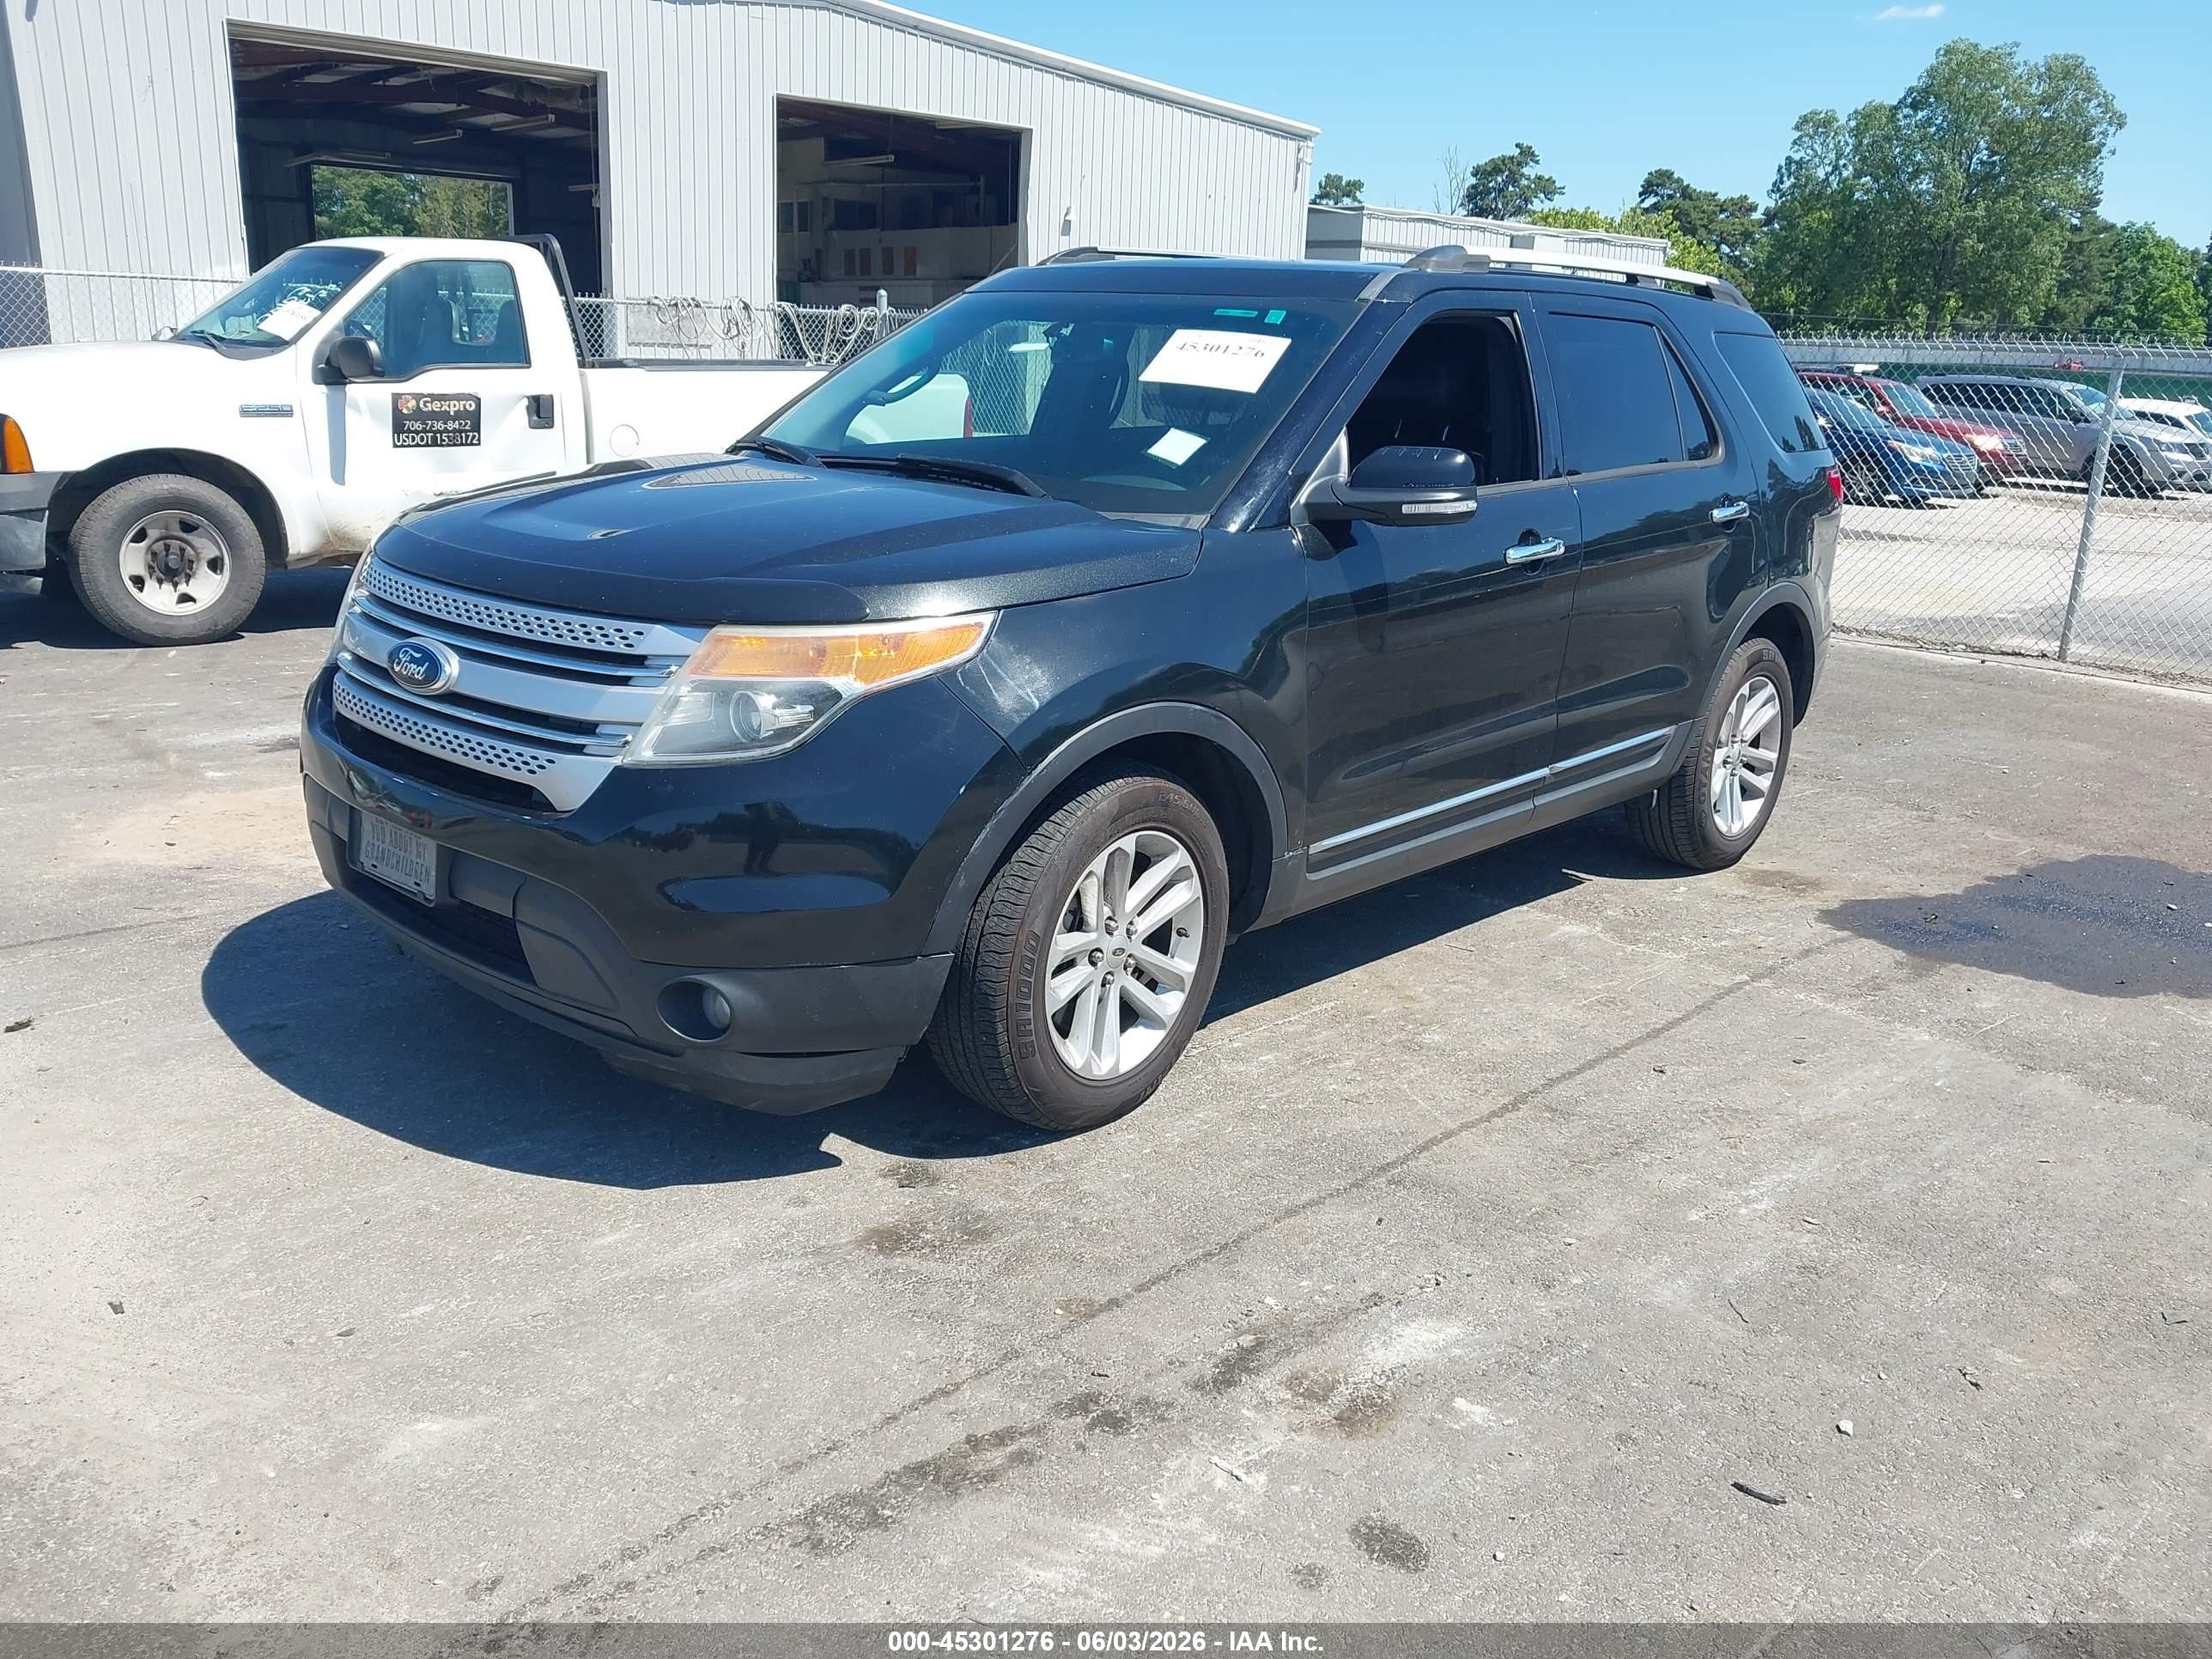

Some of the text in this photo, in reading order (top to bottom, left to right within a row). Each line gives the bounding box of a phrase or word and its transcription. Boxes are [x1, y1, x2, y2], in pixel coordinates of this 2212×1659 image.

[1176, 342, 1265, 358] 45301276
[419, 397, 476, 416] Gexpro
[403, 419, 471, 431] 706-736-8422
[395, 432, 479, 446] USDOT 1538172
[393, 647, 429, 680] Ford
[364, 840, 430, 885] GRANDCHILDREN
